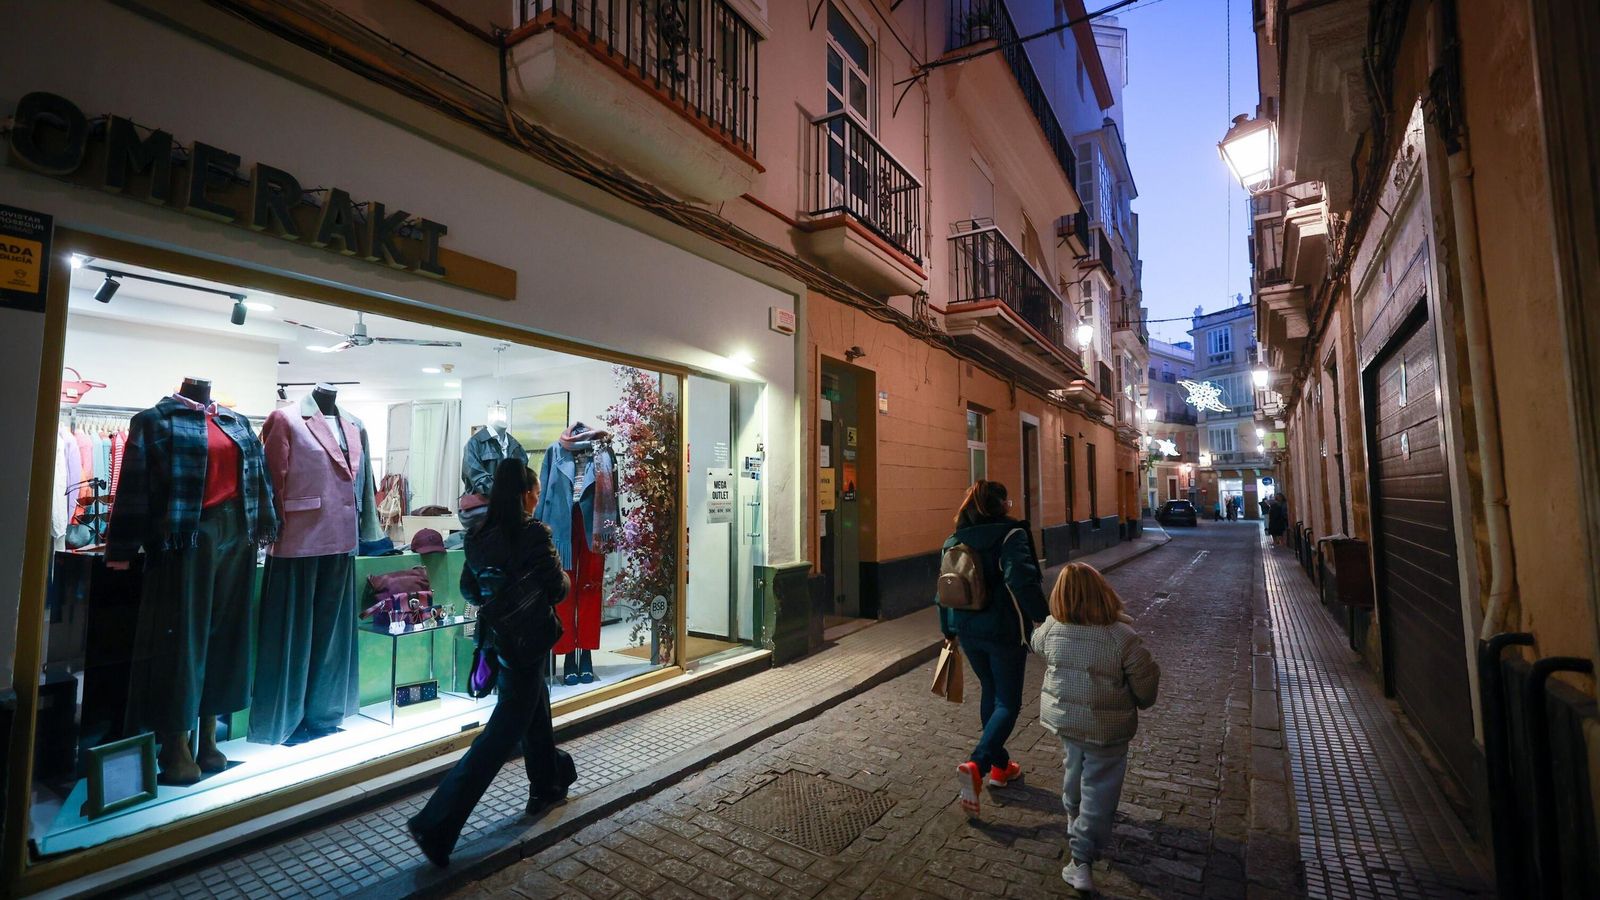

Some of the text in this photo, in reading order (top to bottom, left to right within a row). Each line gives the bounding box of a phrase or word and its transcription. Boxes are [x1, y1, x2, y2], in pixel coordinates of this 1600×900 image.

[11, 91, 448, 278] OMERAKI
[0, 243, 33, 257] ADA
[713, 480, 727, 489] MEGA
[712, 491, 729, 500] OUTLET
